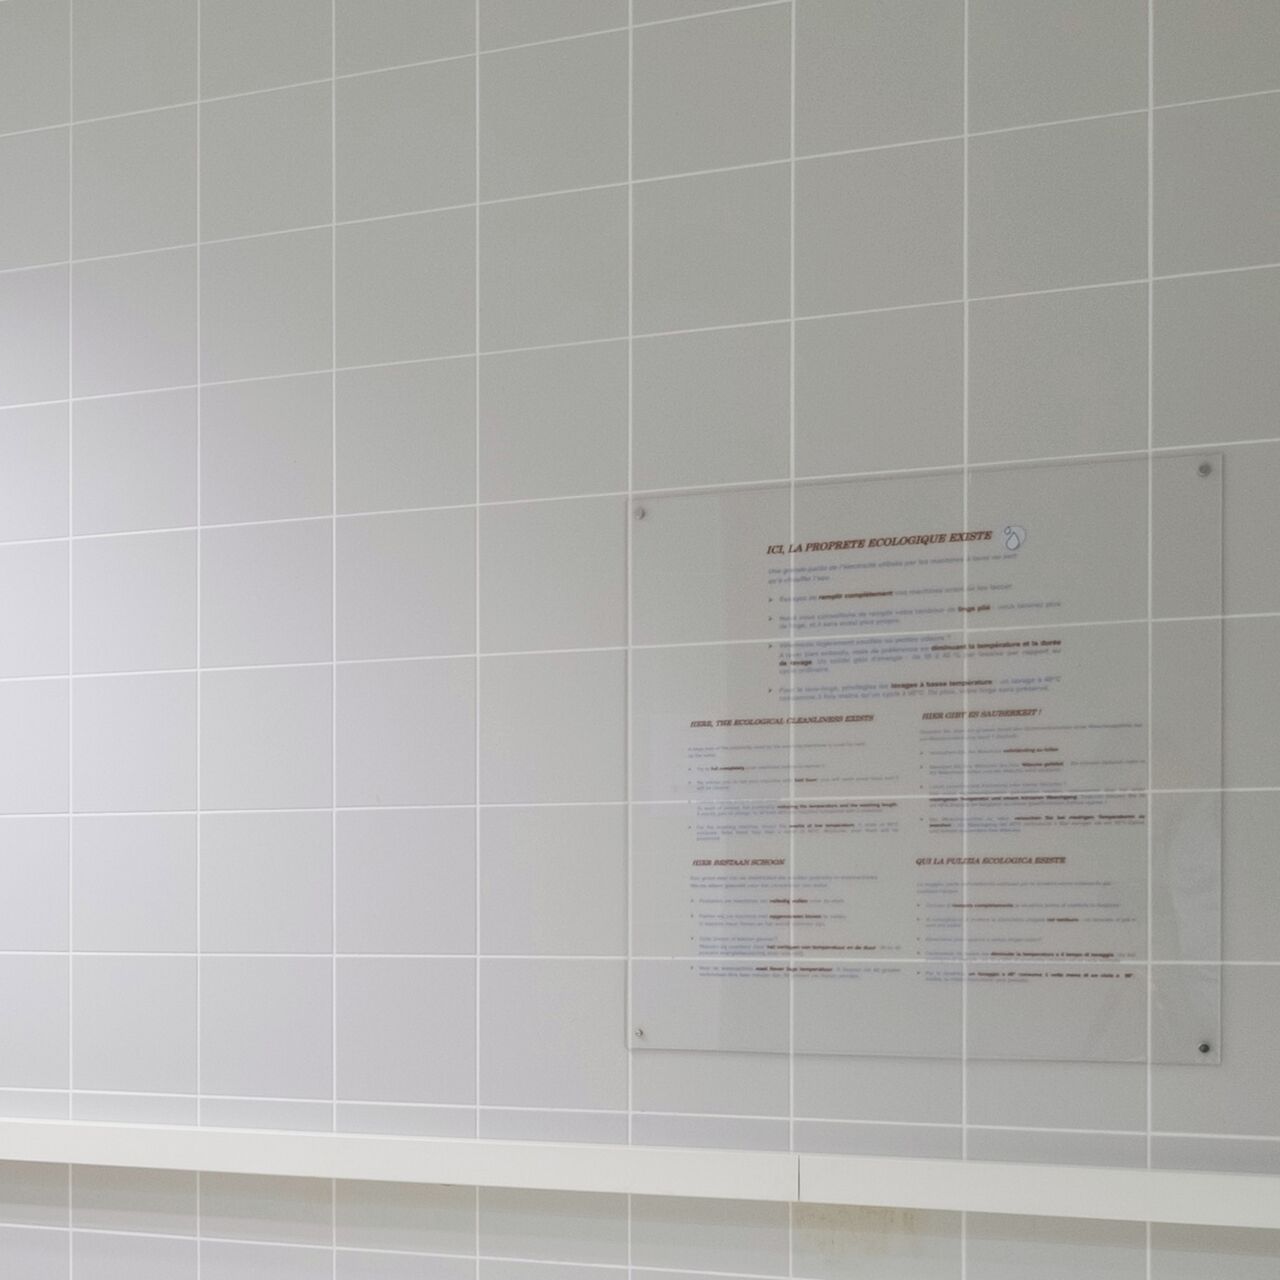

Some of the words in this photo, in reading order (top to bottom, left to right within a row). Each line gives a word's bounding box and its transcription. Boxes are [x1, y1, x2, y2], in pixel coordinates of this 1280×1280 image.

[804, 538, 865, 552] PROPRETE
[868, 533, 946, 547] ECOLOGIQUE
[949, 530, 993, 542] EXISTE
